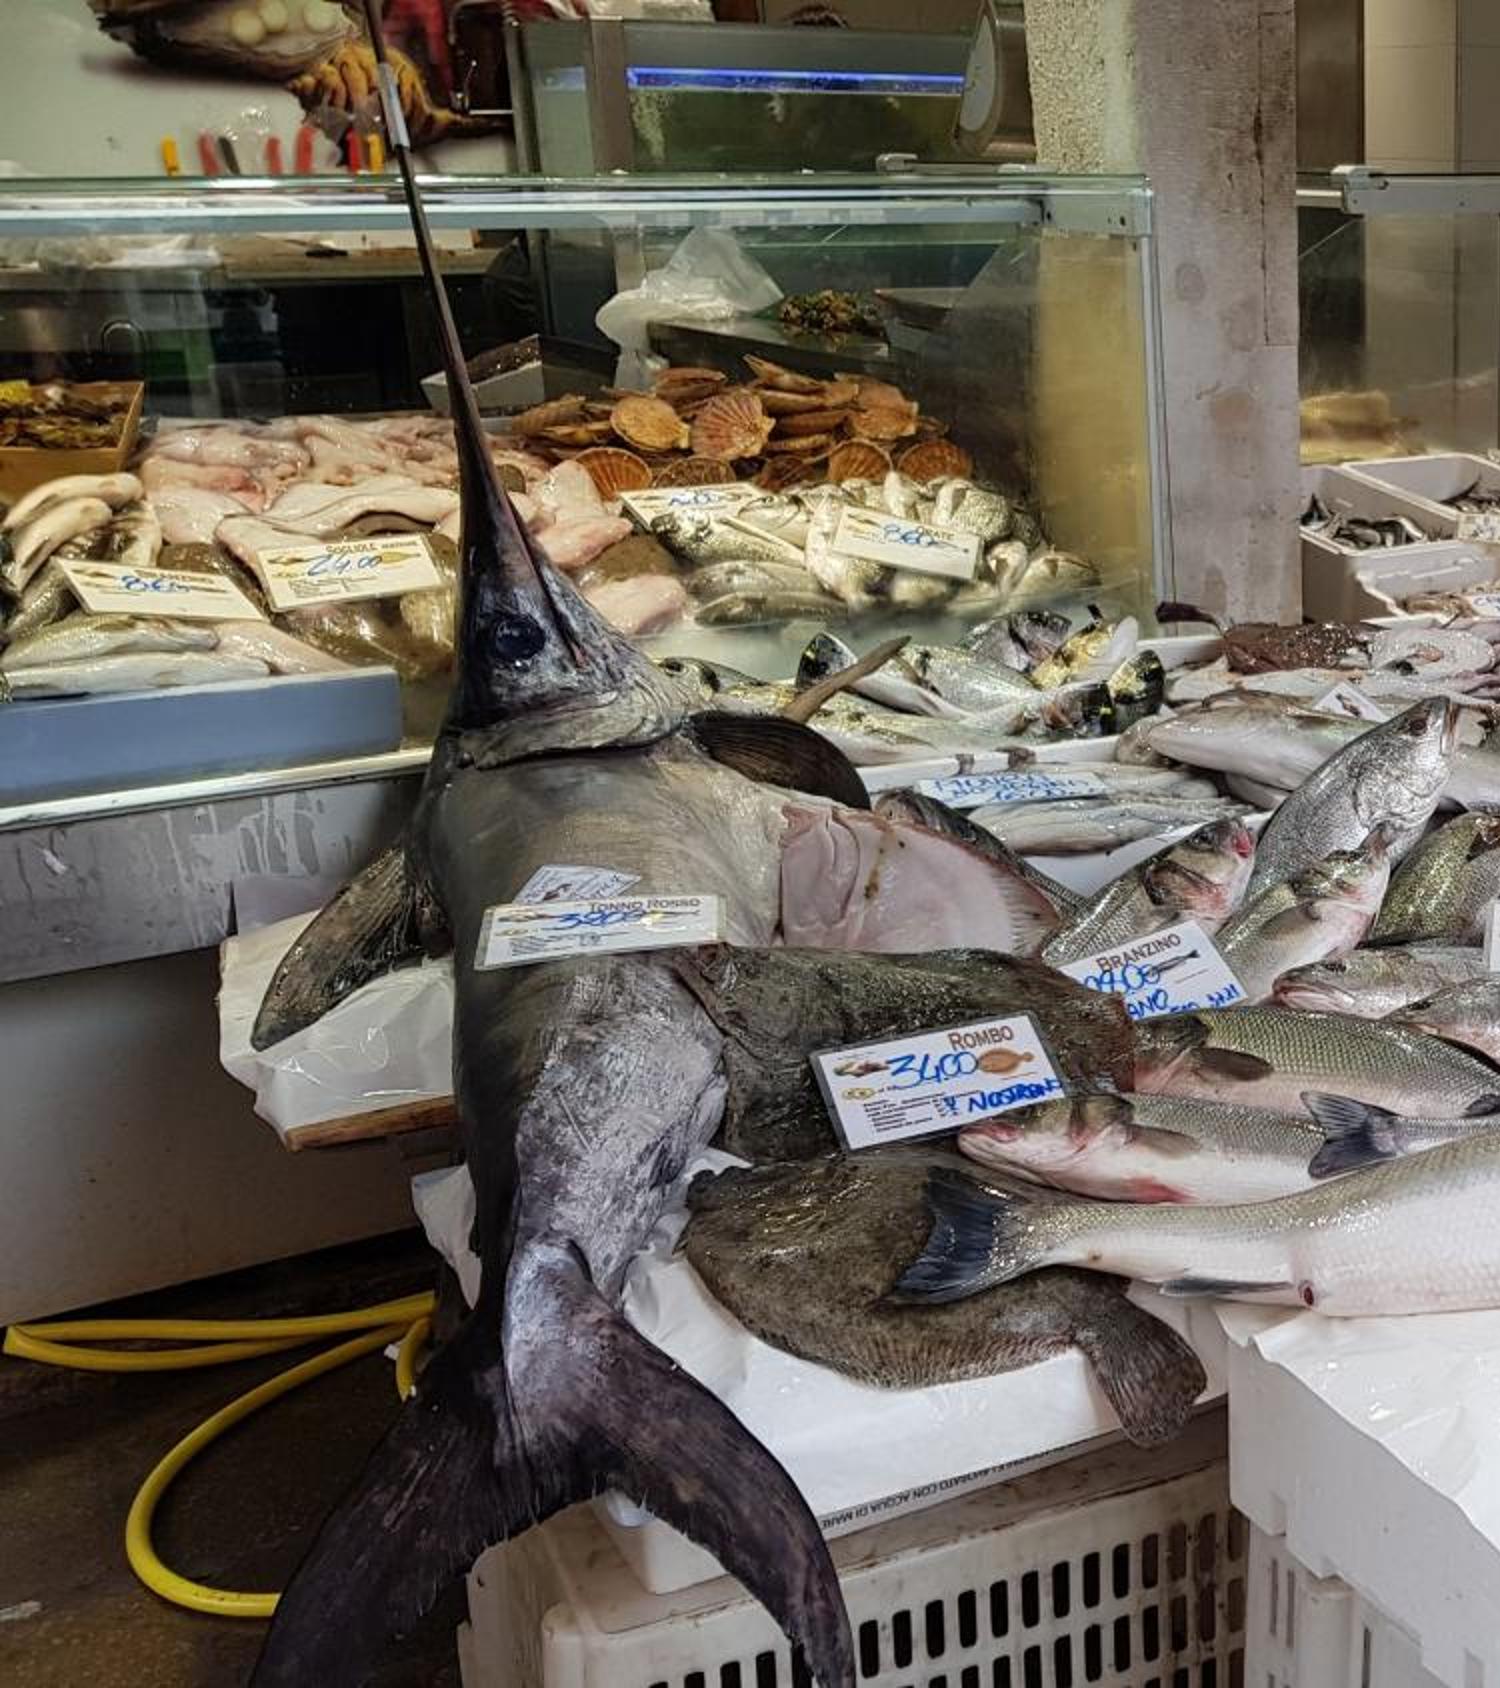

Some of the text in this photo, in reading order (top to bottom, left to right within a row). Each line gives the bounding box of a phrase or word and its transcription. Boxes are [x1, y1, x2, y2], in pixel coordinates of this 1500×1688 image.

[590, 896, 701, 914] TONNO ROSSO
[1095, 933, 1182, 970] BRANZINO
[948, 1025, 1015, 1051] ROMBO
[912, 1482, 938, 1501] CON
[855, 1507, 869, 1518] DI
[870, 1493, 911, 1514] ACQUA
